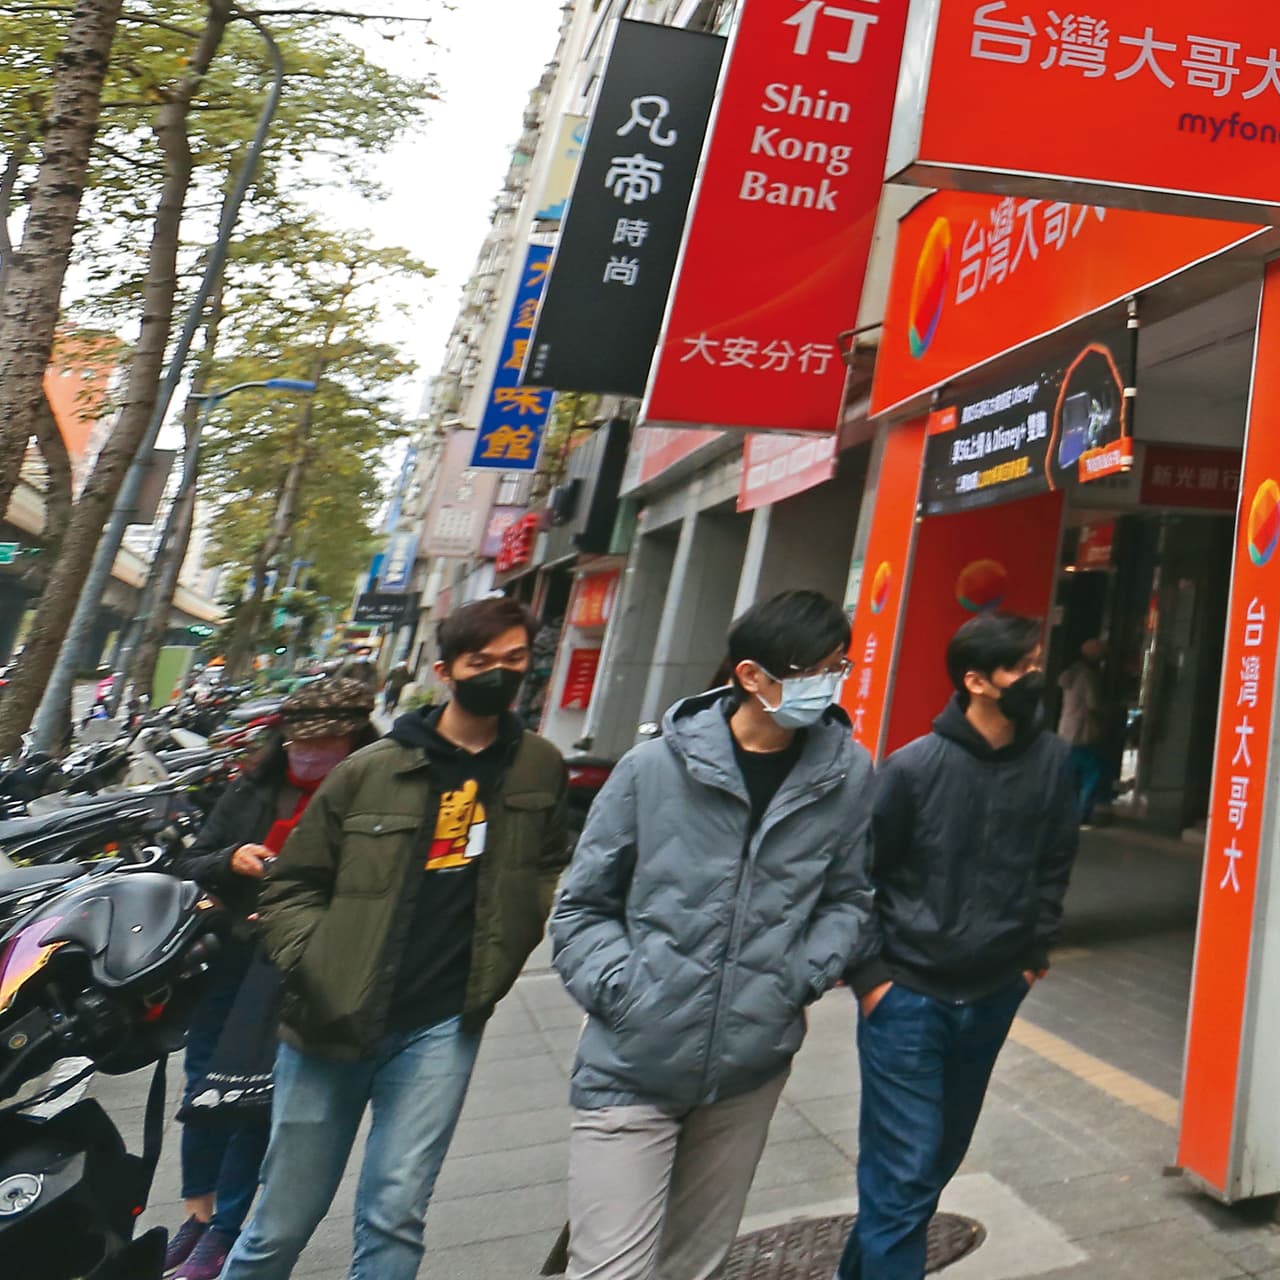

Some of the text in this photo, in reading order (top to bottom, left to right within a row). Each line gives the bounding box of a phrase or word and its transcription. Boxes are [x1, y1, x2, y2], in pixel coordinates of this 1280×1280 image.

[761, 83, 850, 123] Shin
[750, 125, 853, 177] Kong
[738, 170, 839, 212] Bank
[679, 332, 834, 375] 大安分行
[1219, 596, 1266, 894] 台灣大哥大
